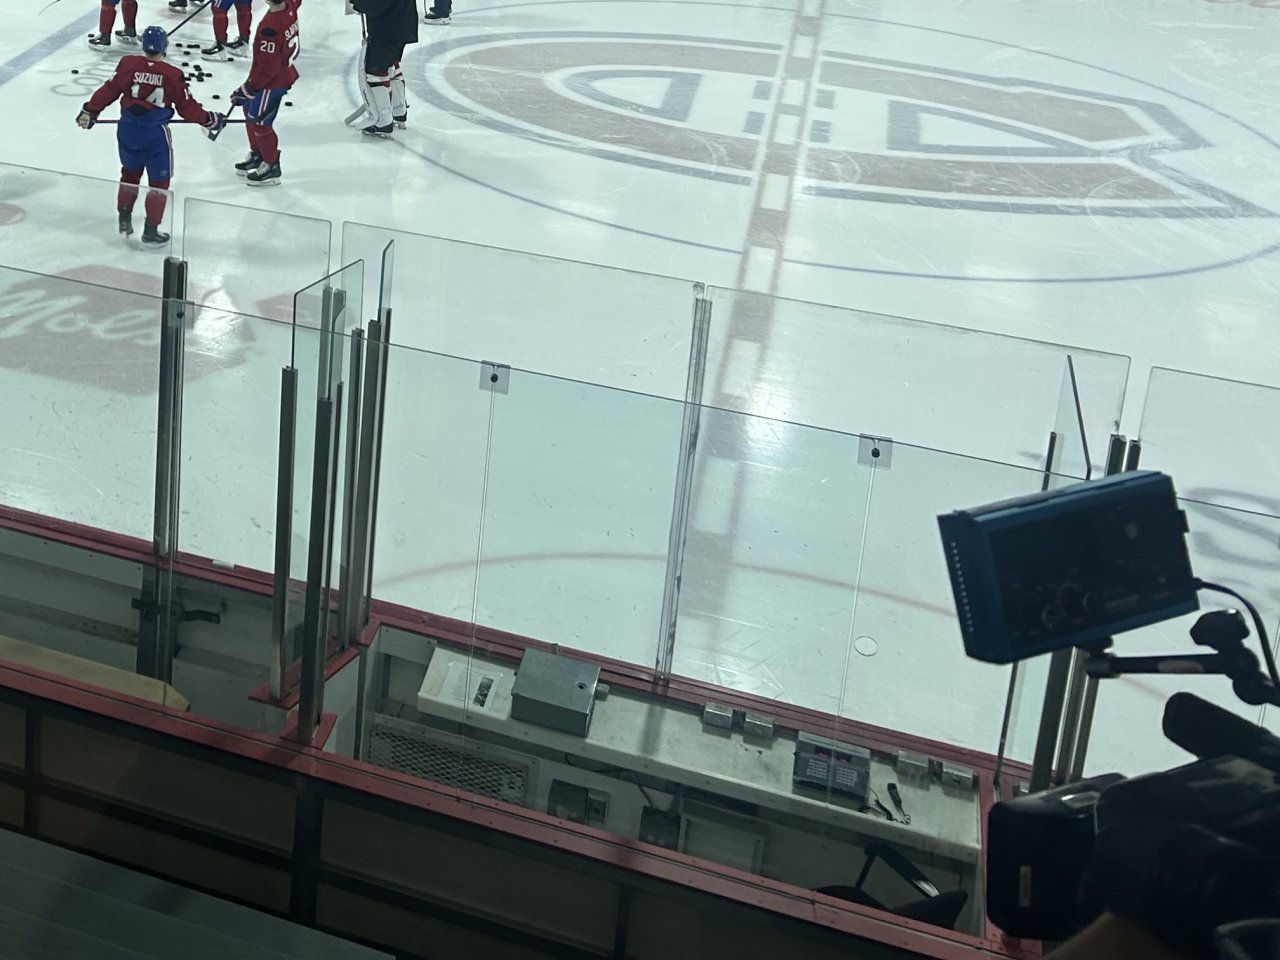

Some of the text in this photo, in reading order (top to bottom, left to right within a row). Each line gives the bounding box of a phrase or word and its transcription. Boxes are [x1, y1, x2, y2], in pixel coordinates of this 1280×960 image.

[260, 40, 276, 54] 20
[133, 71, 163, 86] SUZUKI
[130, 83, 165, 108] 14
